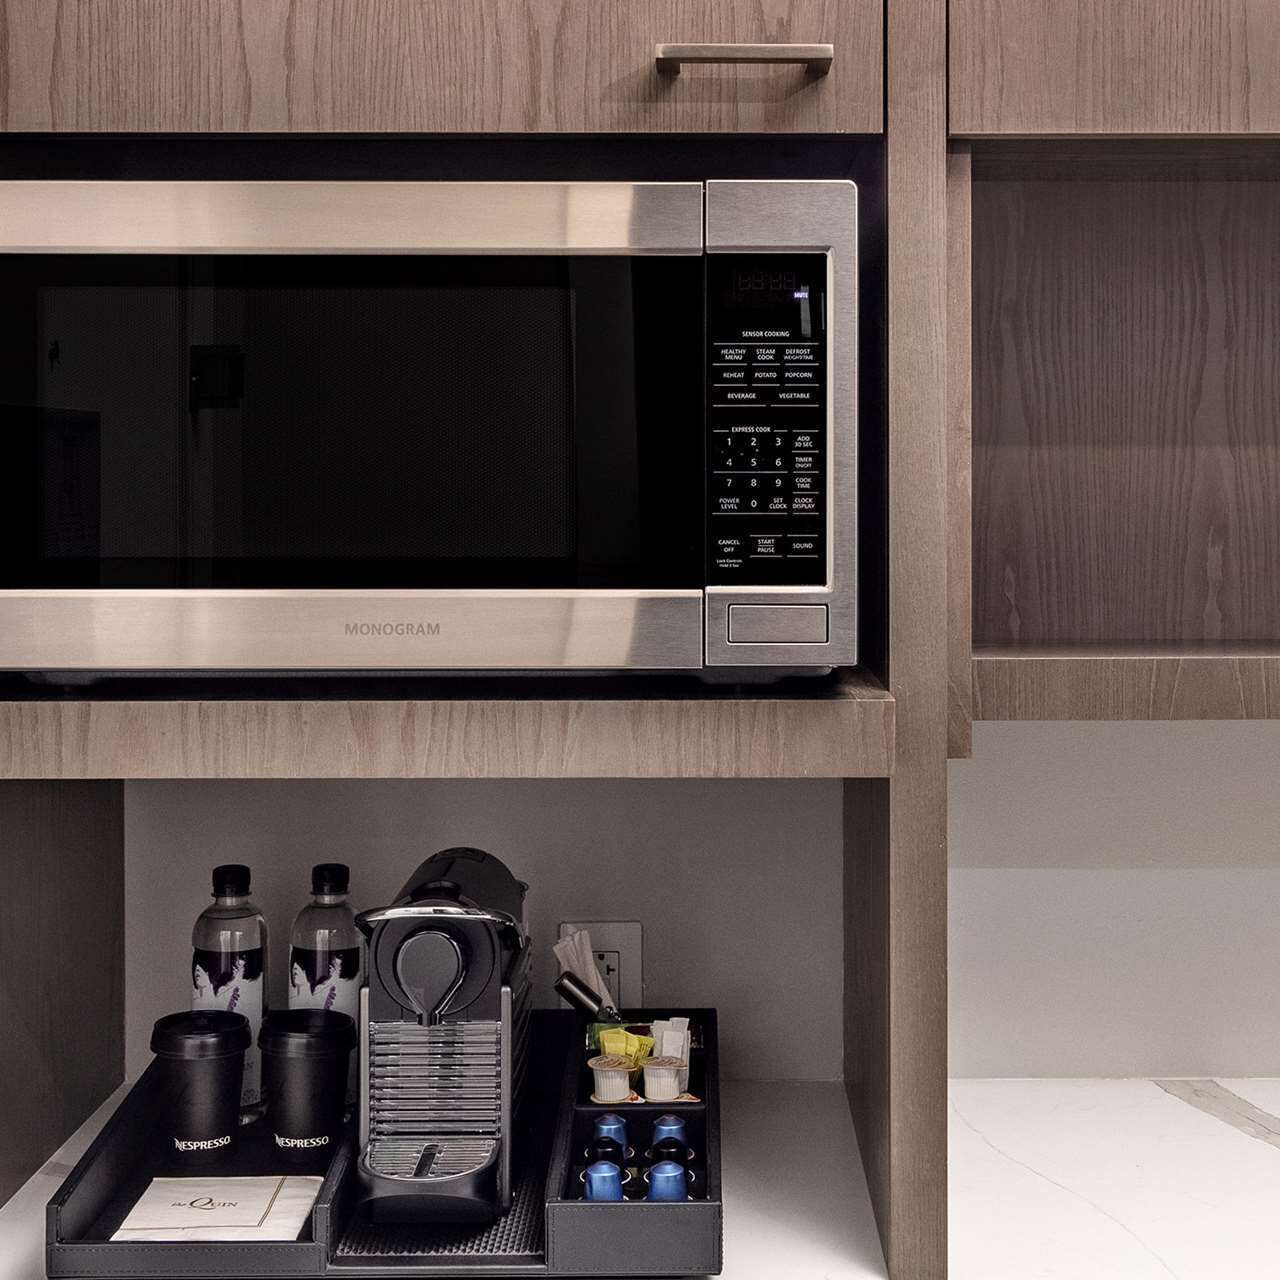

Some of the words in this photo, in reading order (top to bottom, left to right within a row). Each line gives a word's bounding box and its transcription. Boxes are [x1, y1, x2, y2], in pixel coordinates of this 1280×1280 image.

[727, 437, 731, 446] 1
[750, 437, 757, 446] 2
[776, 437, 781, 446] 3
[726, 458, 732, 467] 4
[751, 458, 757, 467] 5
[775, 458, 781, 467] 6
[726, 479, 732, 487] 7
[751, 479, 757, 487] 8
[775, 479, 781, 487] 9
[750, 500, 757, 508] 0
[344, 623, 440, 636] MONOGRAM
[174, 1136, 231, 1151] NESPRESSO
[274, 1133, 329, 1147] NESPRESSO
